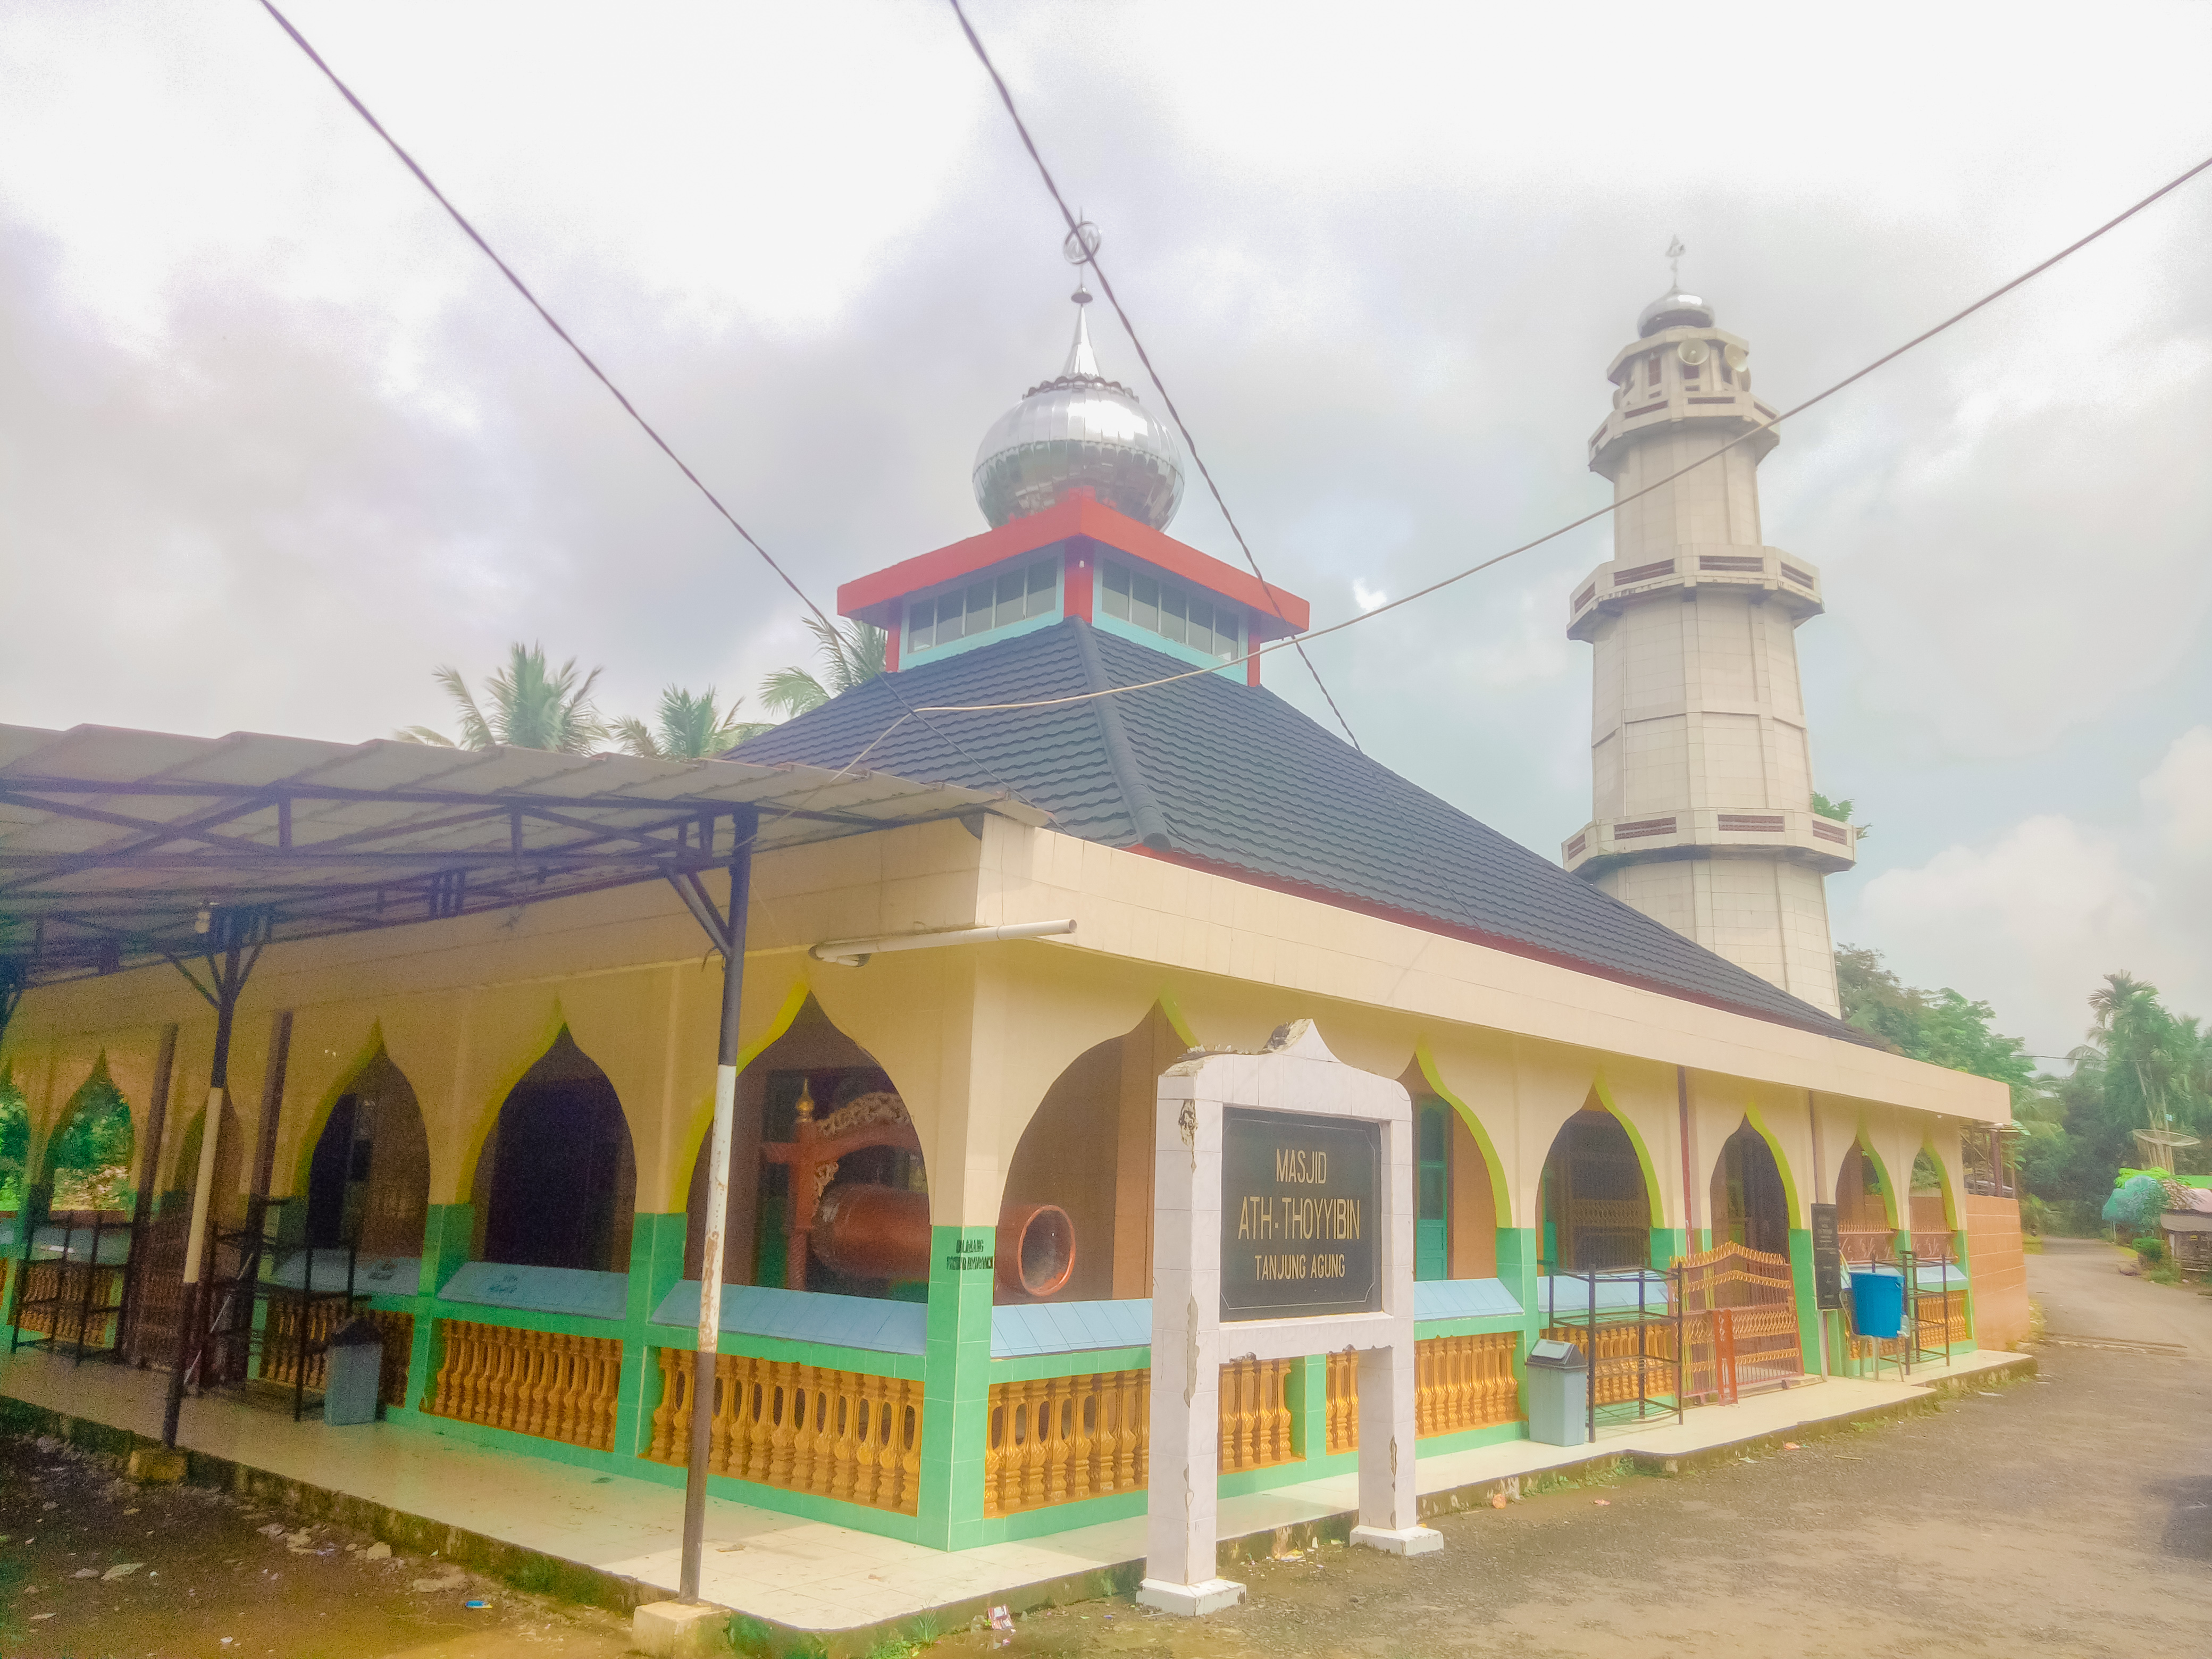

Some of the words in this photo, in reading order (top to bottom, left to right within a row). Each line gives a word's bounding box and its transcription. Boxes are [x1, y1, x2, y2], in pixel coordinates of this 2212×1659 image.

[1276, 1148, 1327, 1184] MASJID
[1254, 1254, 1306, 1280] TANJUNG
[1310, 1253, 1345, 1279] AGUNG
